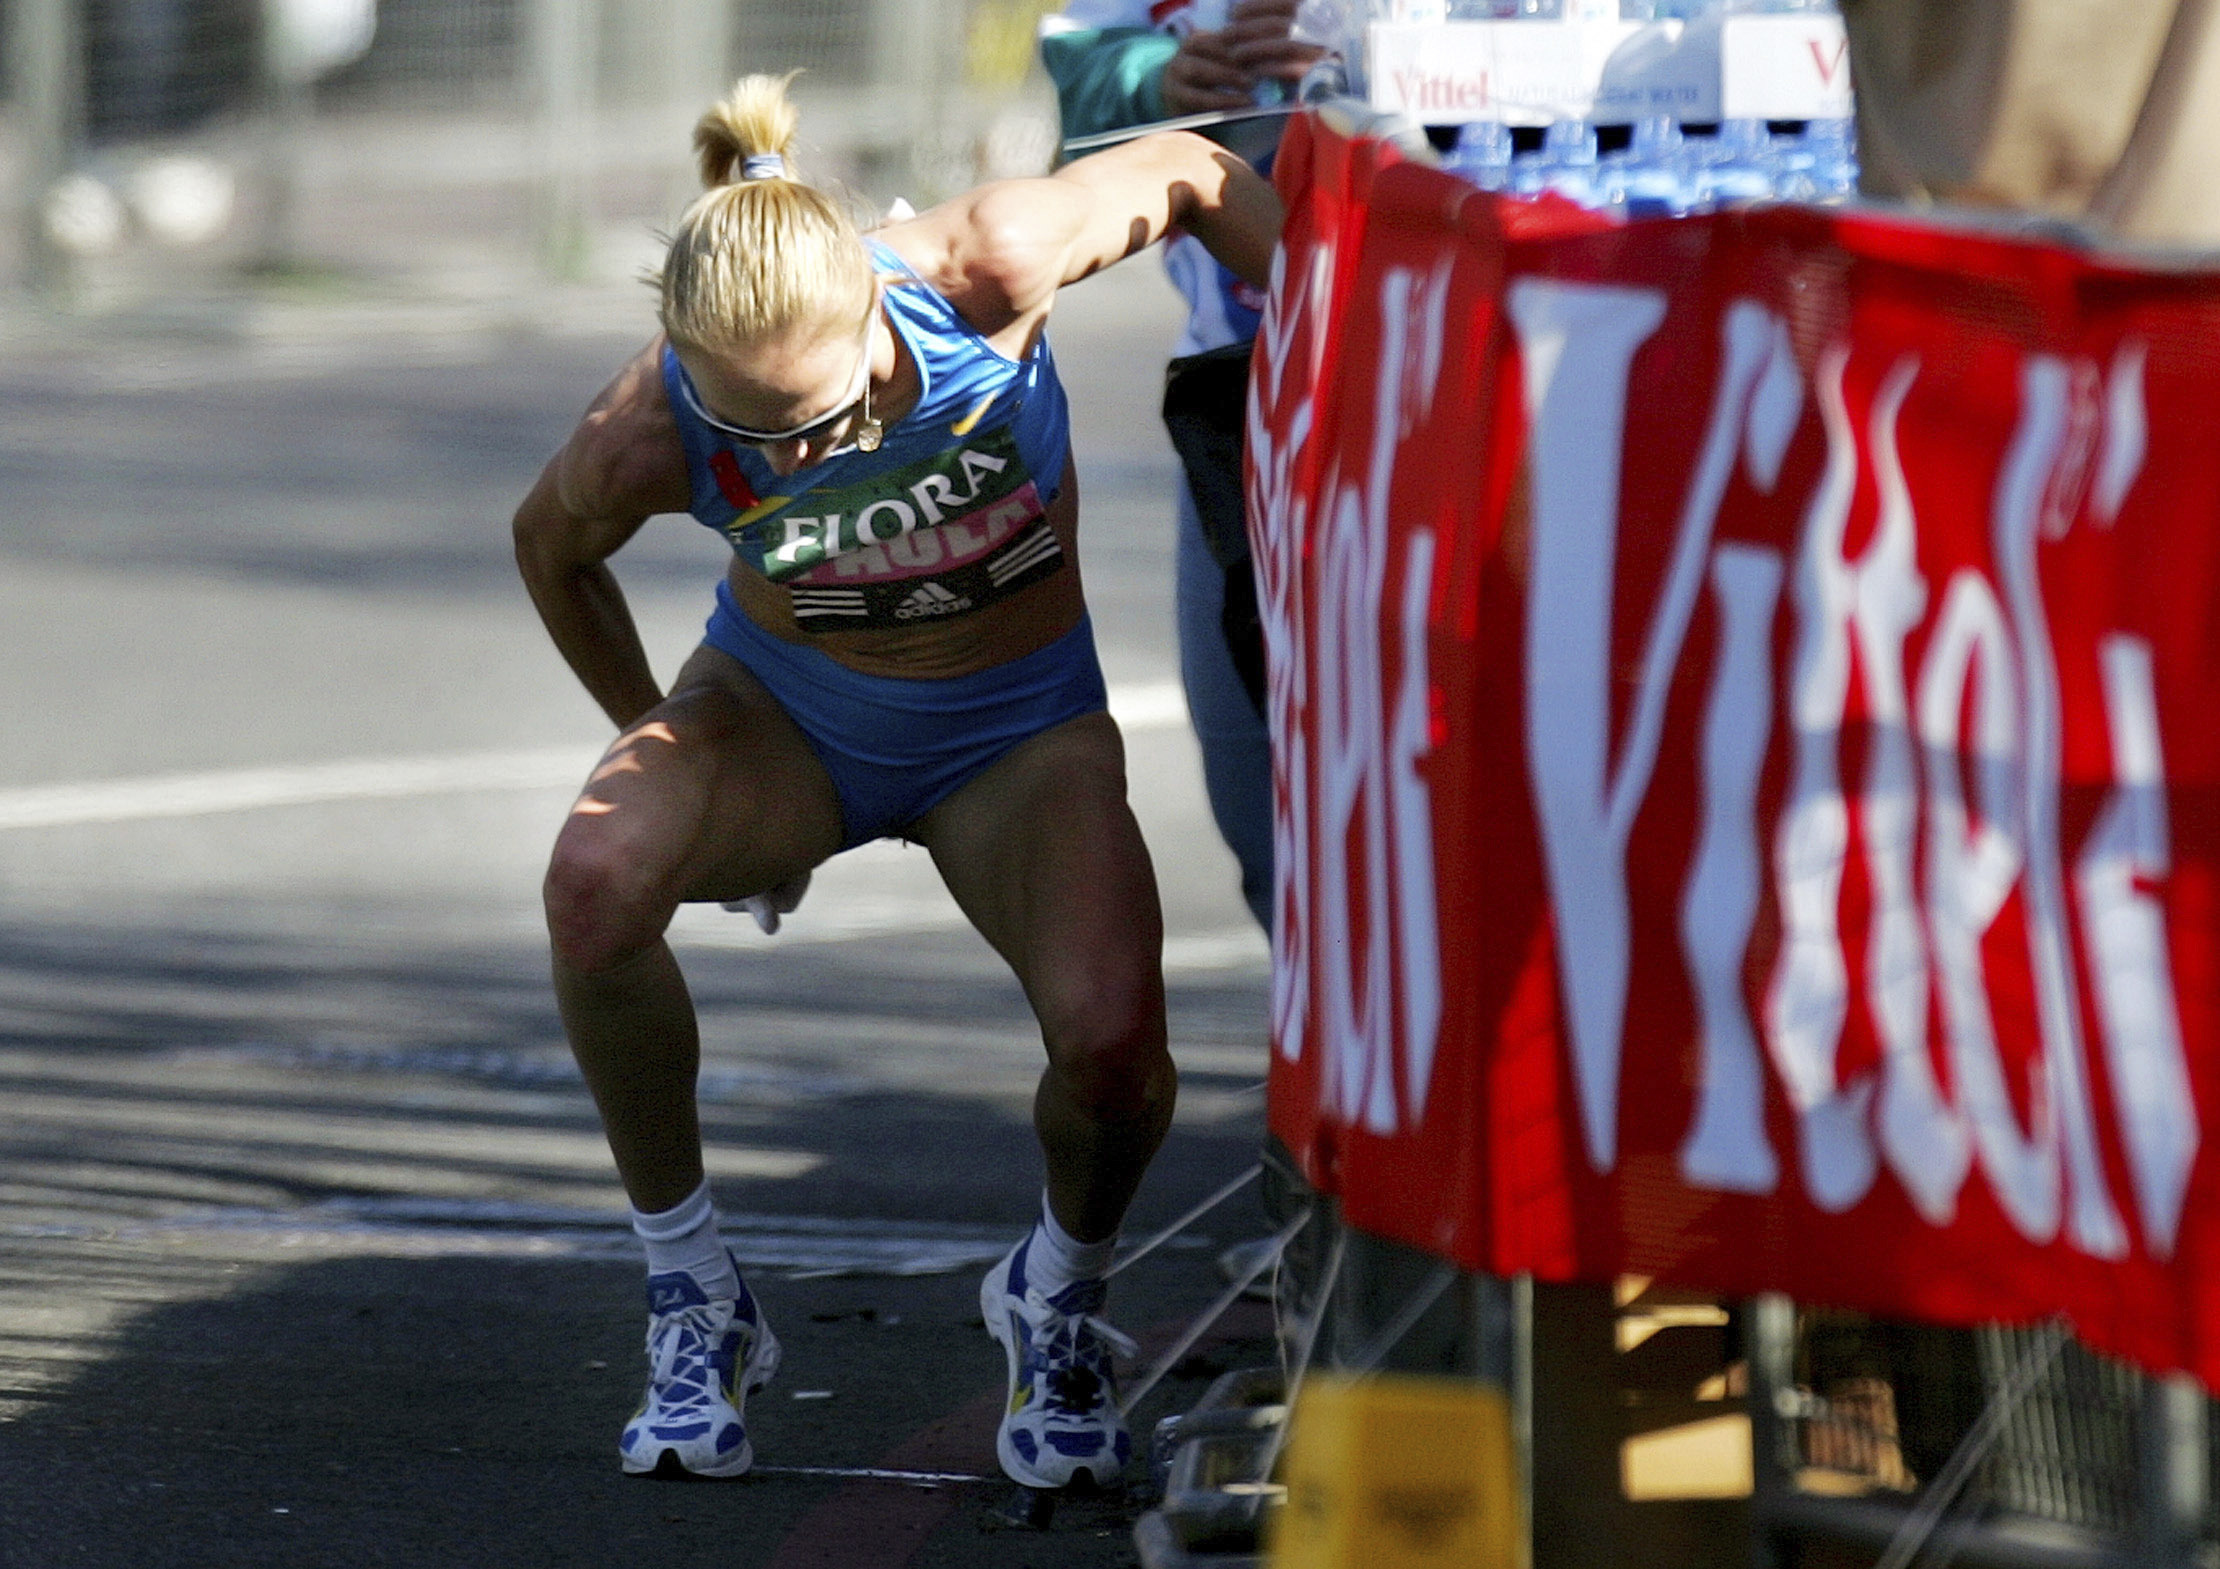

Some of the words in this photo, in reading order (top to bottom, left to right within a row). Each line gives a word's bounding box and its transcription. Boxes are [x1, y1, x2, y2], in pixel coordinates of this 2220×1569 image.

[1393, 70, 1490, 111] Vittel
[776, 449, 1007, 563] FLORA
[794, 500, 1029, 582] AULA
